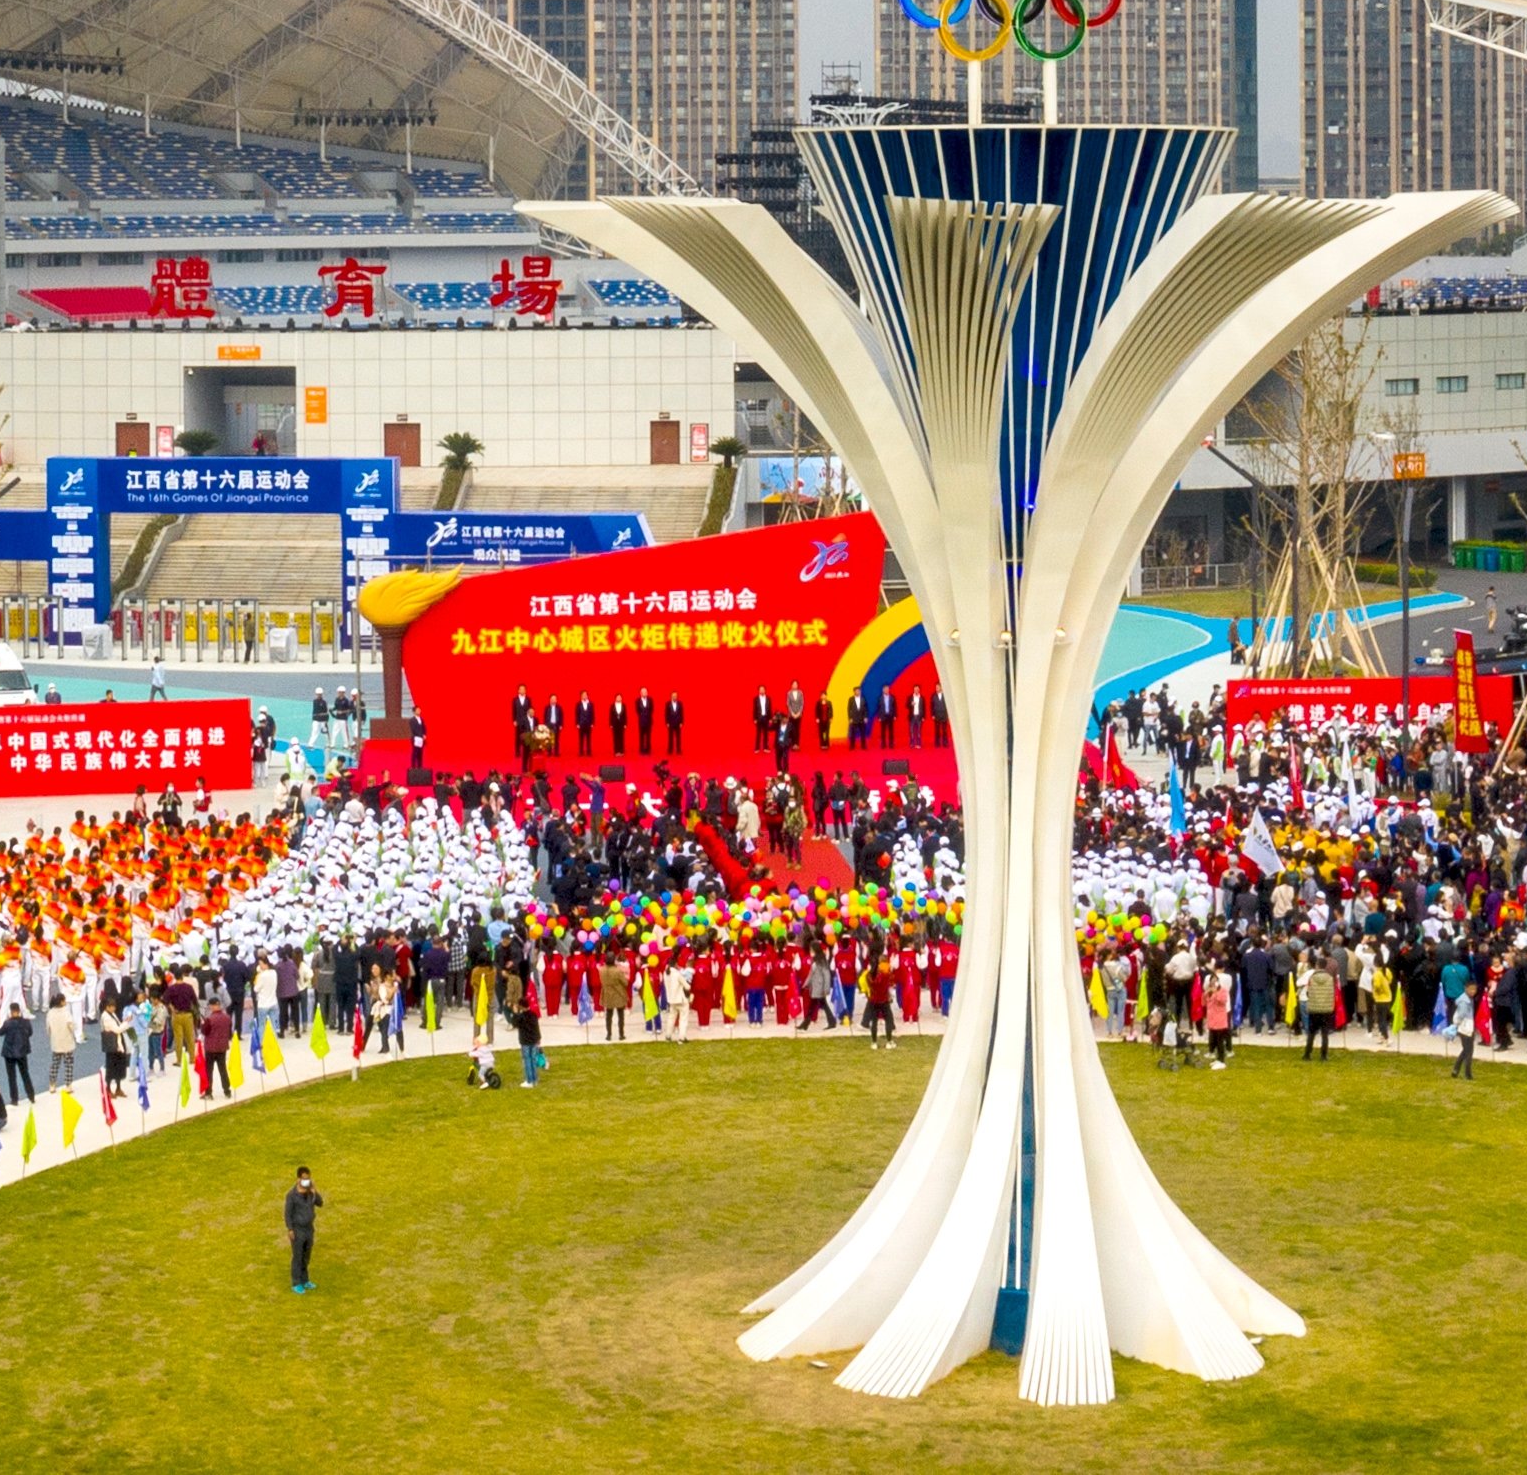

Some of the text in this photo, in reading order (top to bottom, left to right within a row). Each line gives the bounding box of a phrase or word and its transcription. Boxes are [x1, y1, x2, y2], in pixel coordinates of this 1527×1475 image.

[148, 256, 562, 319] 體育場
[126, 469, 310, 490] 江西省第十六届运动会
[127, 493, 309, 505] The 16th Games Of Jiangxi Province
[461, 526, 565, 539] 江西省第十六届运动会
[530, 588, 757, 617] 江西省第十六届运动会
[452, 619, 828, 655] 九江中心城区火炬传递收火仪式
[11, 749, 202, 773] 中华民族伟大复兴
